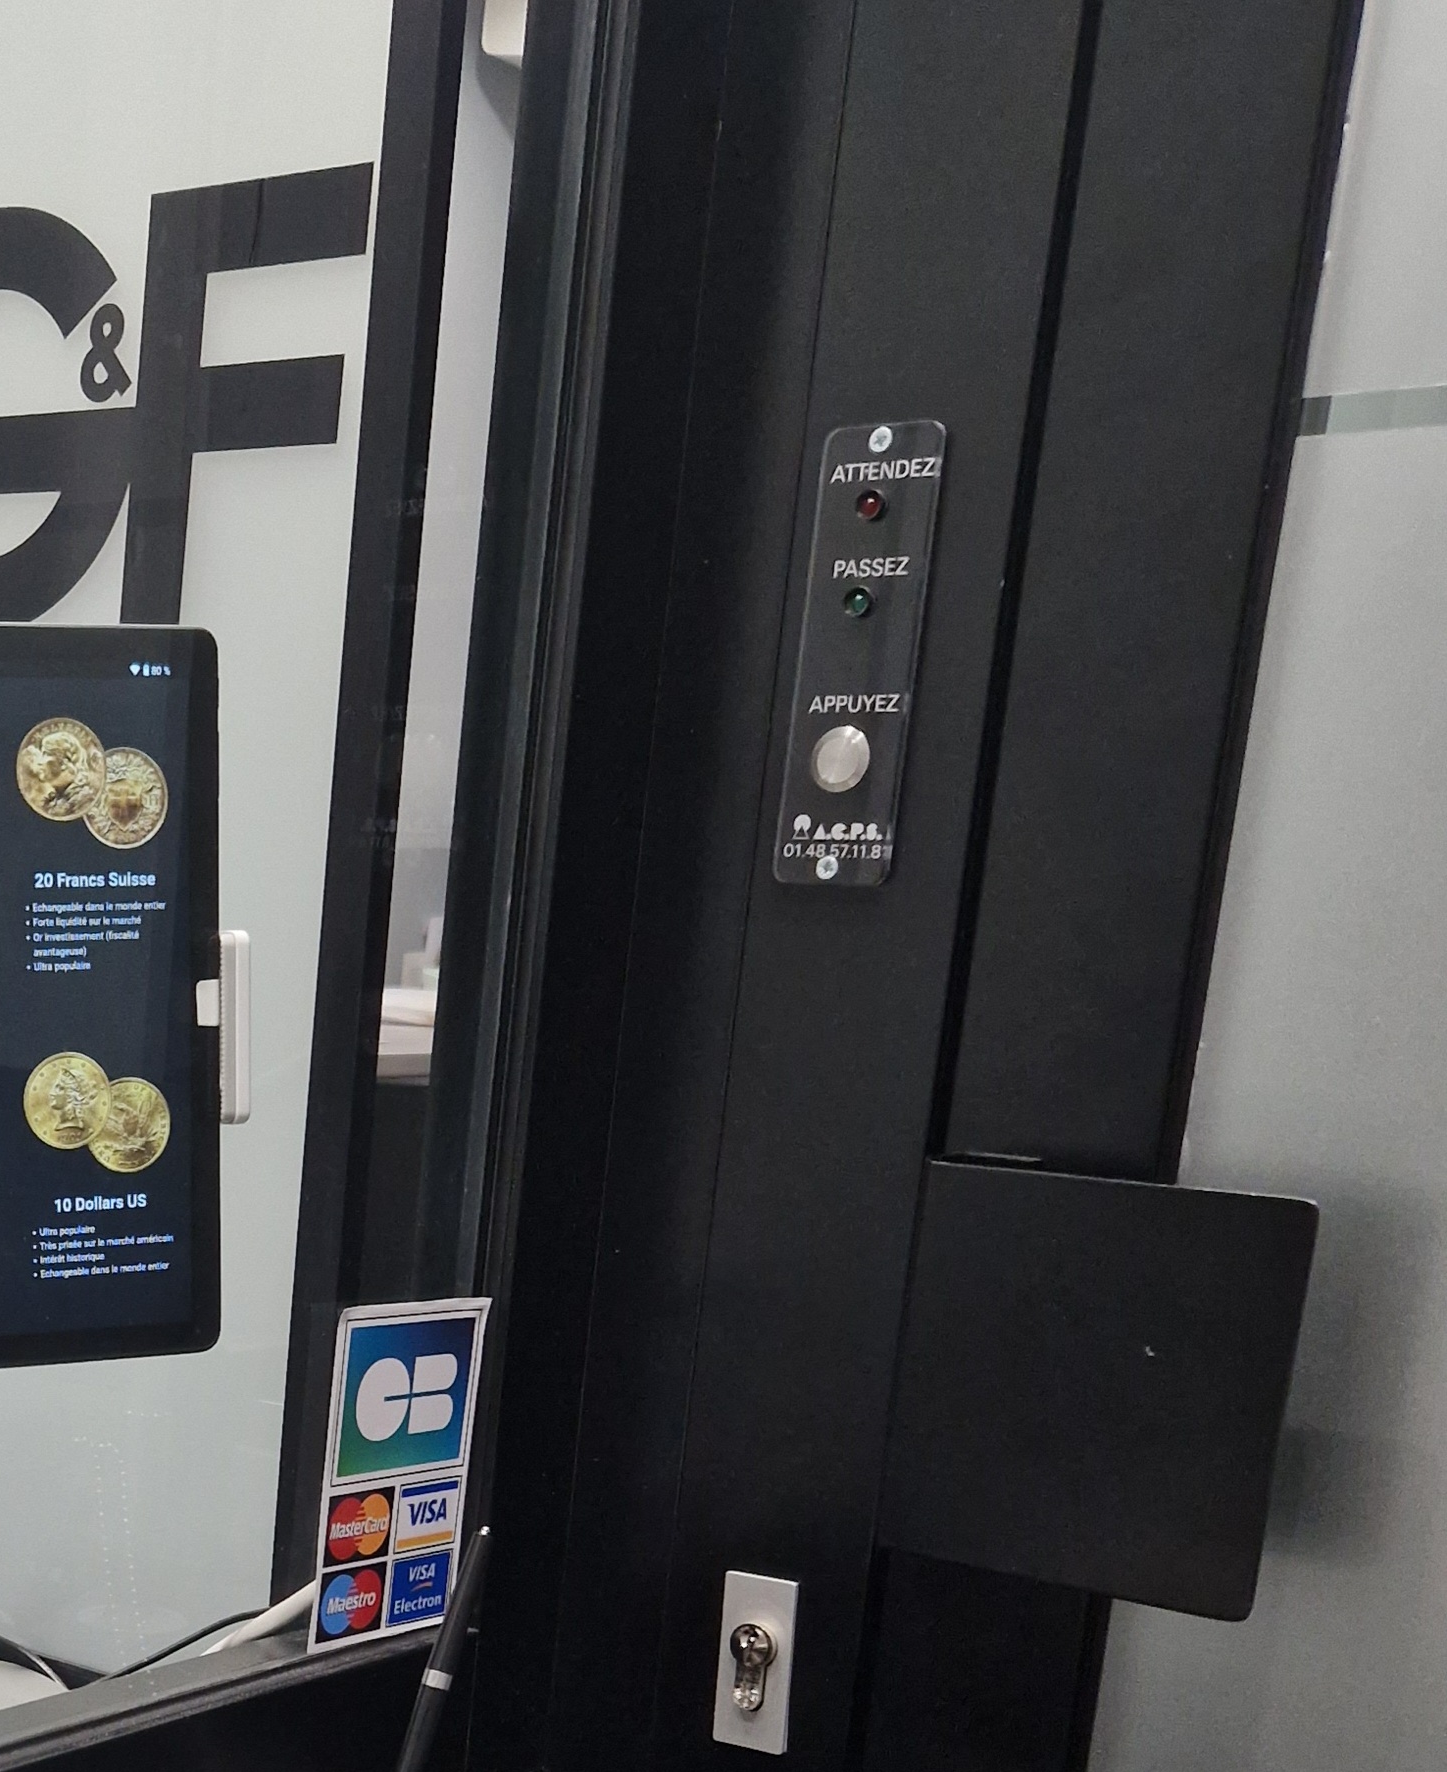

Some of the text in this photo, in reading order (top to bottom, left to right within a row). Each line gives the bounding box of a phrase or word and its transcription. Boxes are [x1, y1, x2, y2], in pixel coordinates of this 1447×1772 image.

[830, 457, 936, 484] ATTENDEZ
[833, 556, 910, 579] PASSEZ
[808, 693, 901, 714] APPUYEZ
[34, 871, 156, 888] 20 Francs Suisse
[115, 902, 142, 911] monde
[33, 933, 43, 942] Or
[54, 961, 91, 973] populaire
[55, 1193, 147, 1213] 10 Dollars US
[355, 1353, 458, 1442] CB
[407, 1498, 447, 1526] VISA
[329, 1515, 389, 1540] MasterCard
[409, 1562, 436, 1582] VISA
[326, 1591, 377, 1615] Maestro
[393, 1594, 442, 1615] Electron
